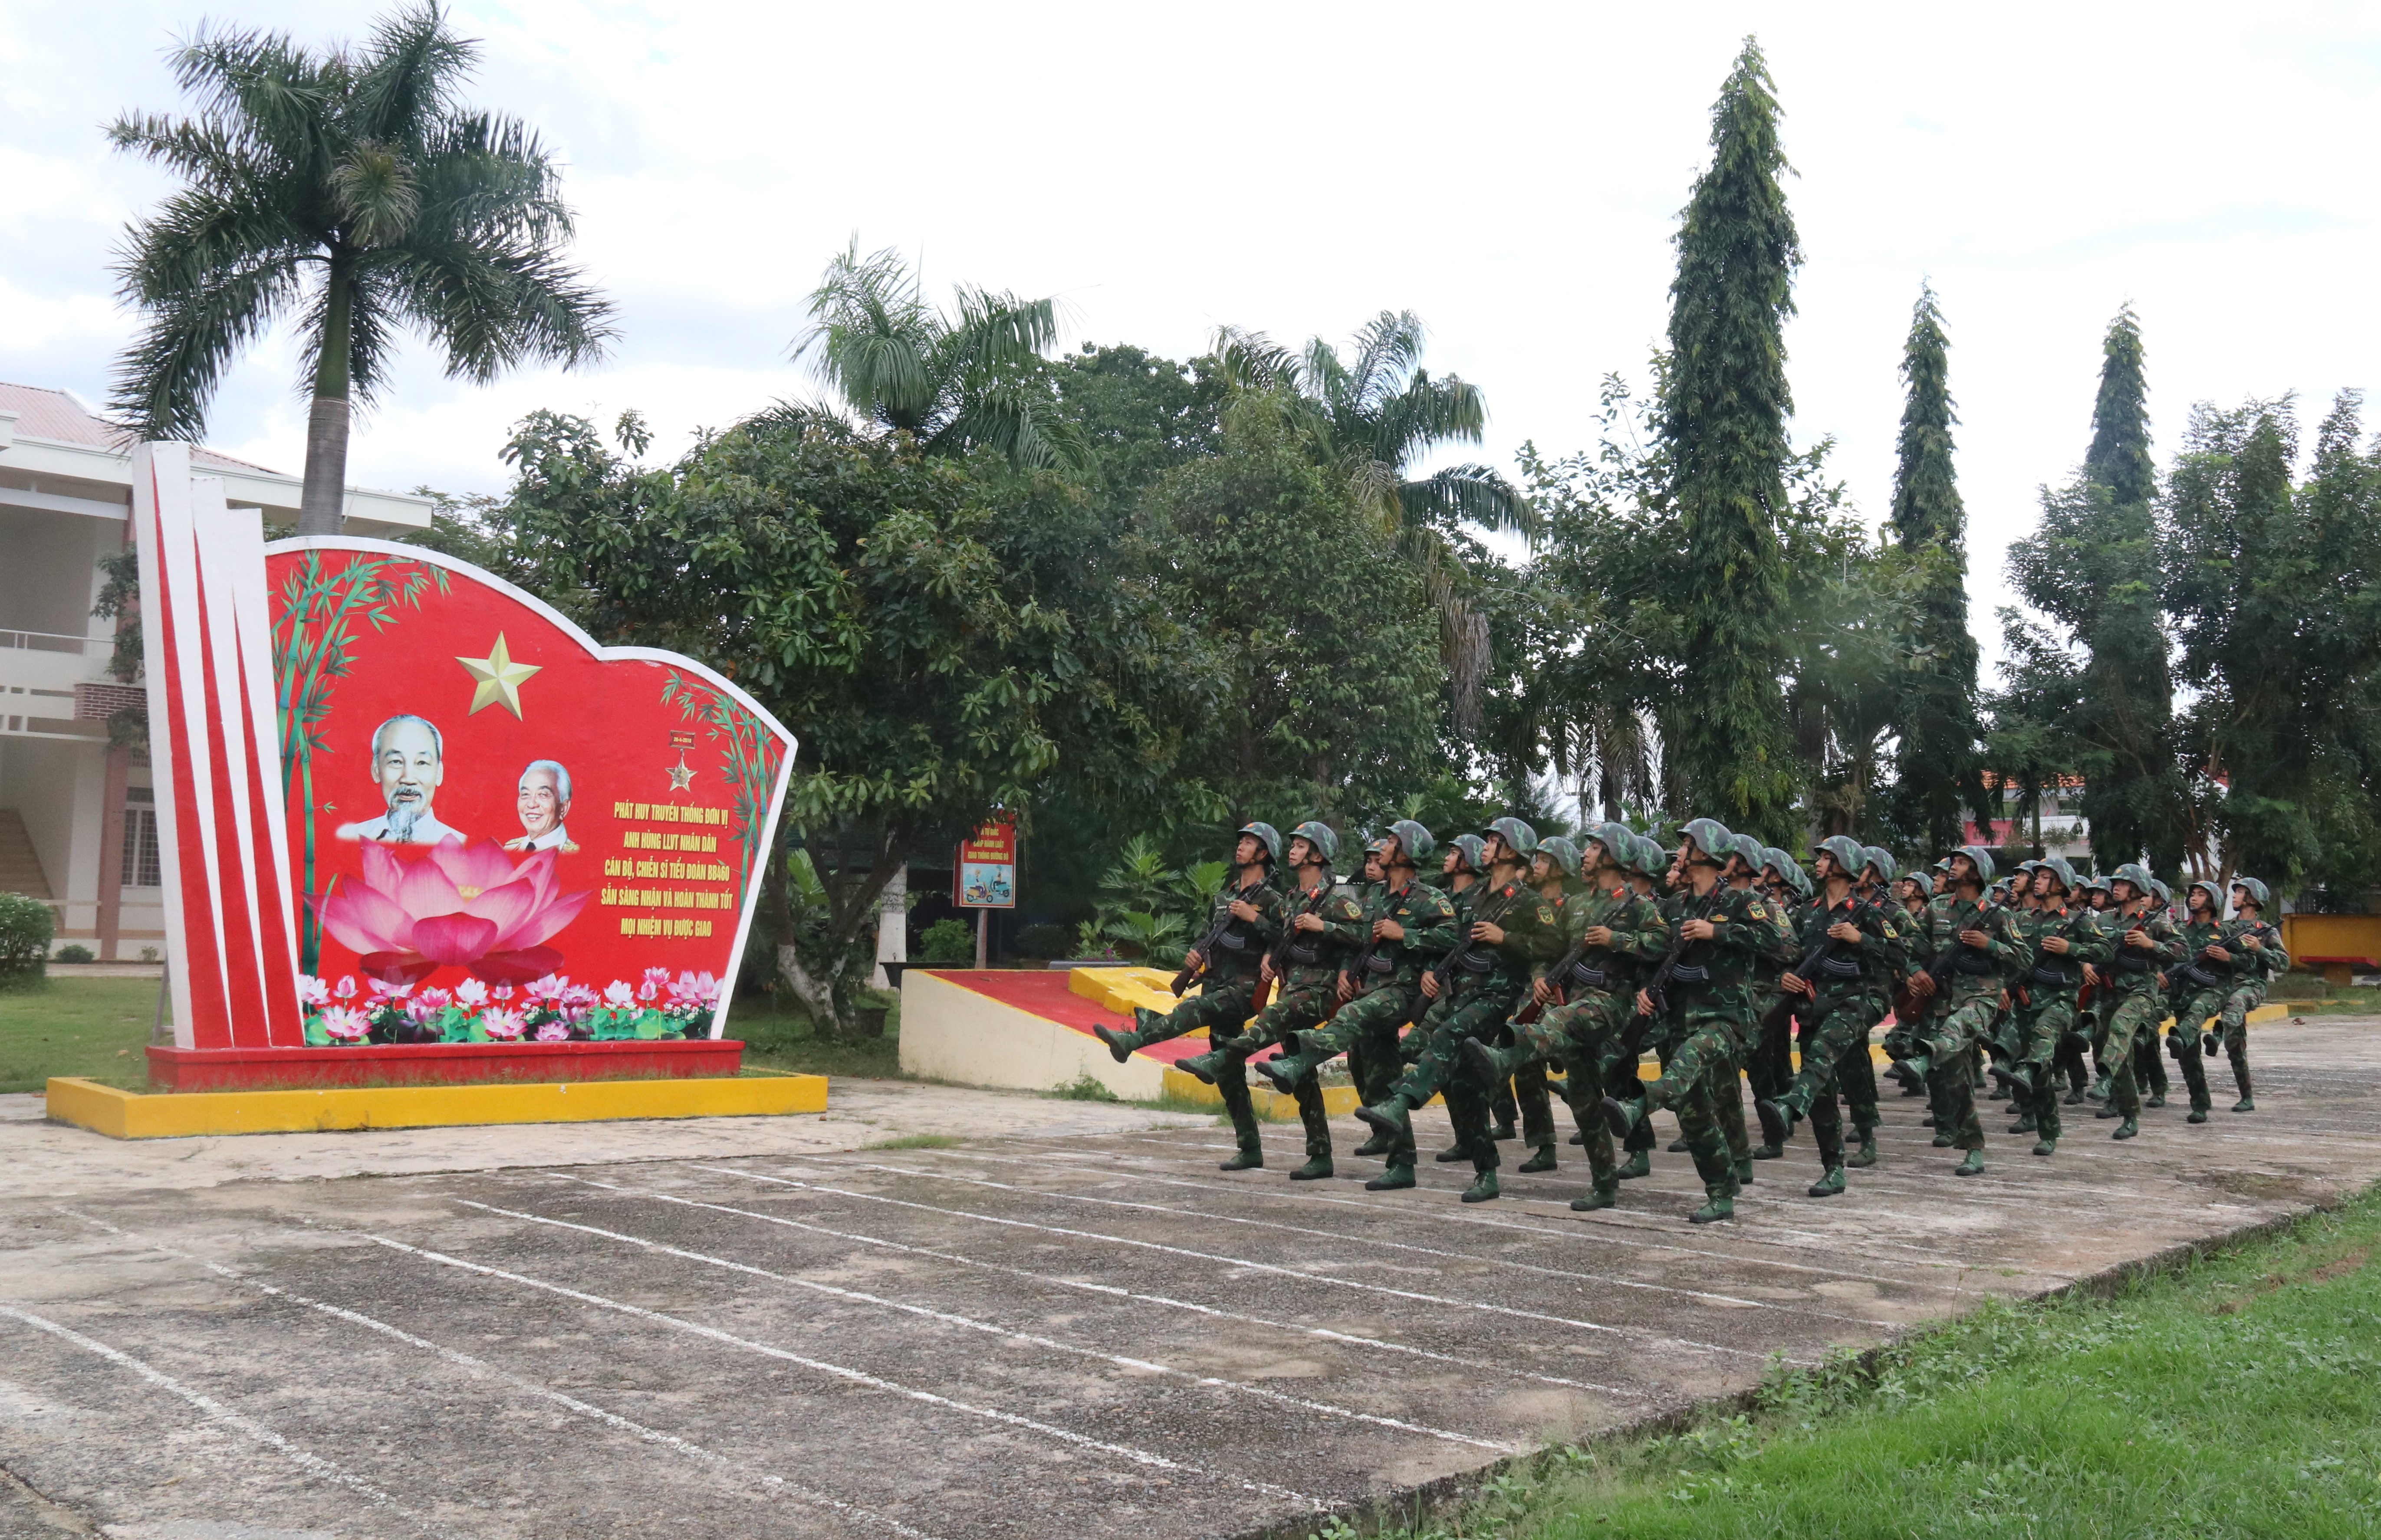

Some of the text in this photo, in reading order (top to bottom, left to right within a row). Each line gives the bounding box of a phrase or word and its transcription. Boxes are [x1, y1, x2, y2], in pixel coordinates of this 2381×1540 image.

[614, 799, 634, 818] PHÁT
[635, 803, 650, 820] HUY
[681, 801, 704, 823] THỐNG
[705, 807, 720, 824] ĐƠN
[721, 809, 729, 829] VỊ
[624, 829, 717, 853] ANH HÙNG LLVT NHÂN DÂN
[605, 856, 621, 876] CÁN
[622, 857, 635, 880] BỘ,
[660, 860, 668, 878] SĨ
[670, 857, 685, 879] TIỂU
[687, 860, 707, 880] ĐOÀN
[707, 864, 730, 881] BB460
[618, 886, 640, 906] SÀNG
[641, 887, 662, 910] NHẬN
[663, 888, 673, 907] VÀ
[674, 889, 694, 908] HOÀN
[696, 889, 719, 909] THÀNH
[720, 888, 733, 909] TỐT
[621, 916, 712, 940] MỌI NHIỆM VỤ ĐƯỢC GIAO
